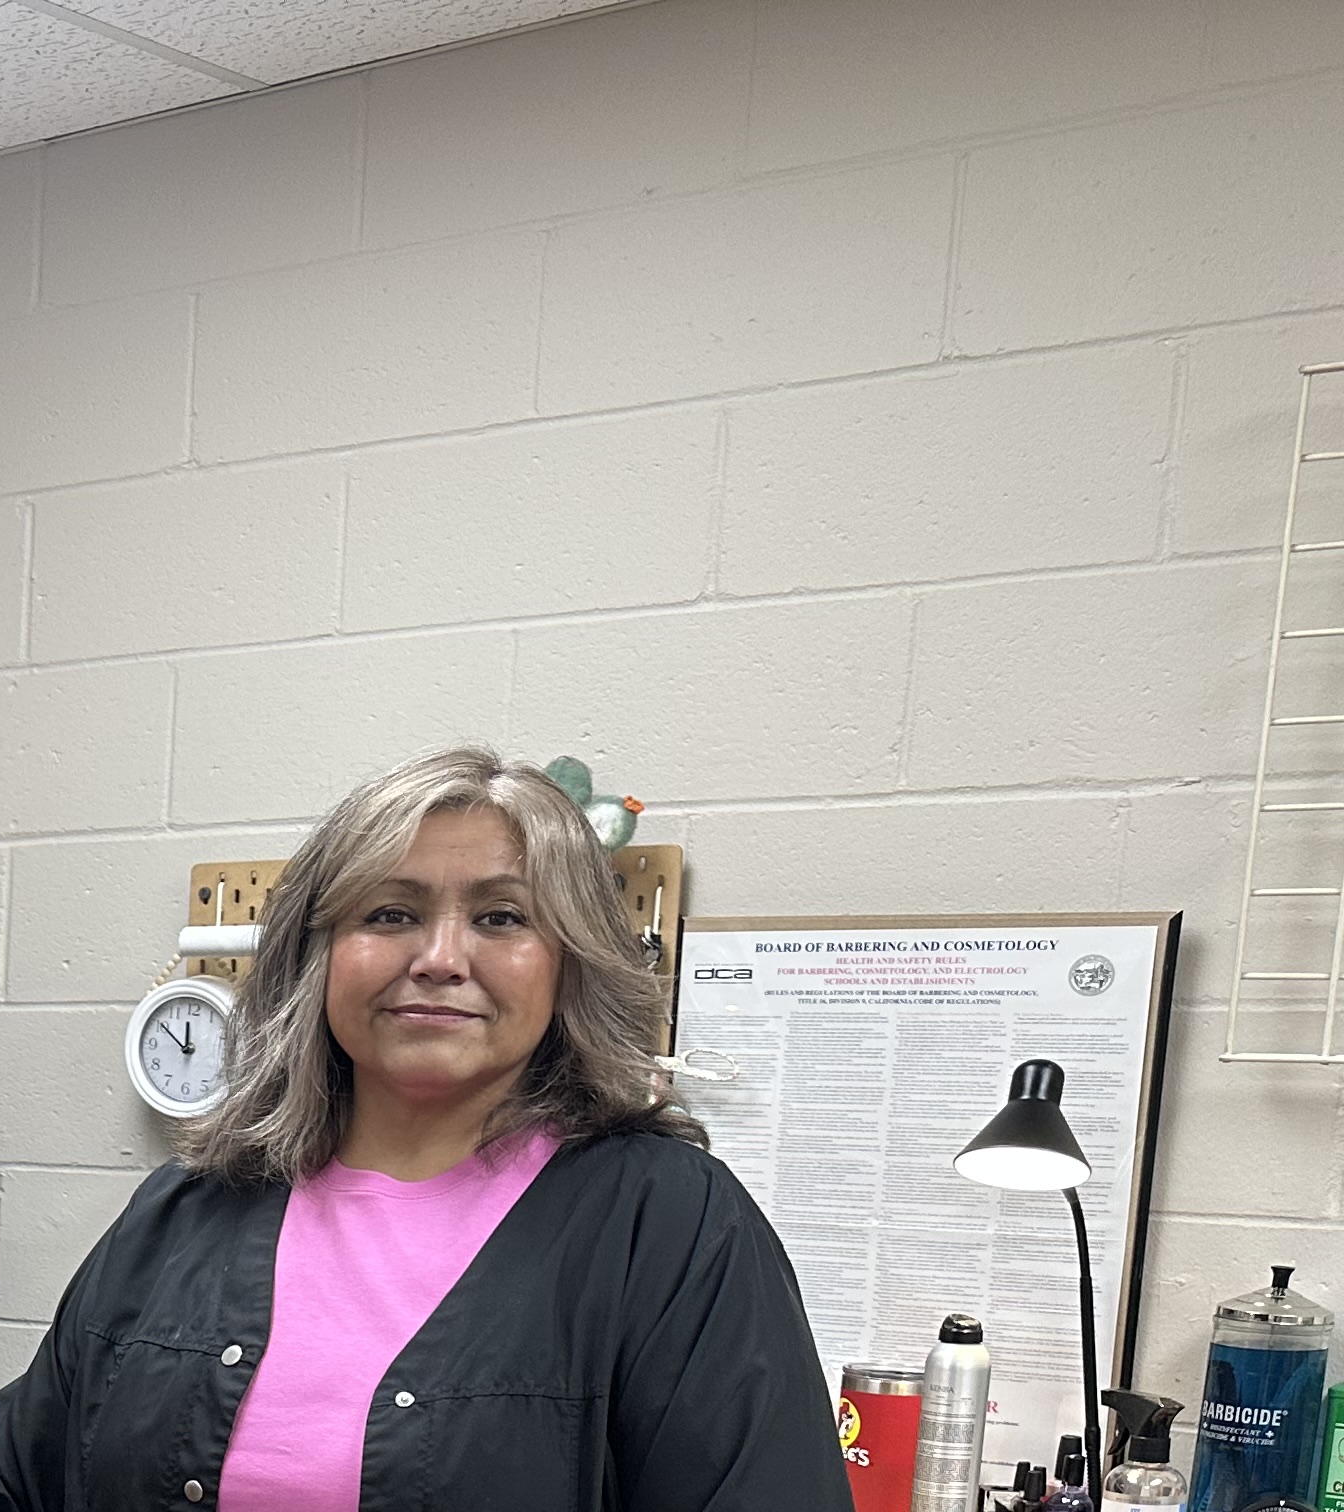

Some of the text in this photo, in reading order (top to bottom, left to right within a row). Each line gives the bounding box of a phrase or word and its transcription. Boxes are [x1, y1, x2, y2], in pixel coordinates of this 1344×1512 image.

[755, 940, 1059, 953] BOARD OF BARBERING AND COSMETOLOGY
[836, 957, 873, 965] HEALTH
[897, 957, 933, 965] SAFETY
[694, 968, 753, 980] dca
[933, 967, 952, 975] AND
[954, 967, 1028, 975] ELECTROLOGY
[824, 978, 867, 986] SCHOOLS
[168, 1004, 180, 1020] 11
[188, 1003, 201, 1017] 12
[156, 1019, 170, 1034] 10
[149, 1038, 158, 1050] 9
[151, 1058, 160, 1071] 8
[164, 1073, 173, 1086] 7
[199, 1079, 209, 1093] 5
[181, 1082, 190, 1095] 6
[1202, 1399, 1282, 1427] BARBICIDE
